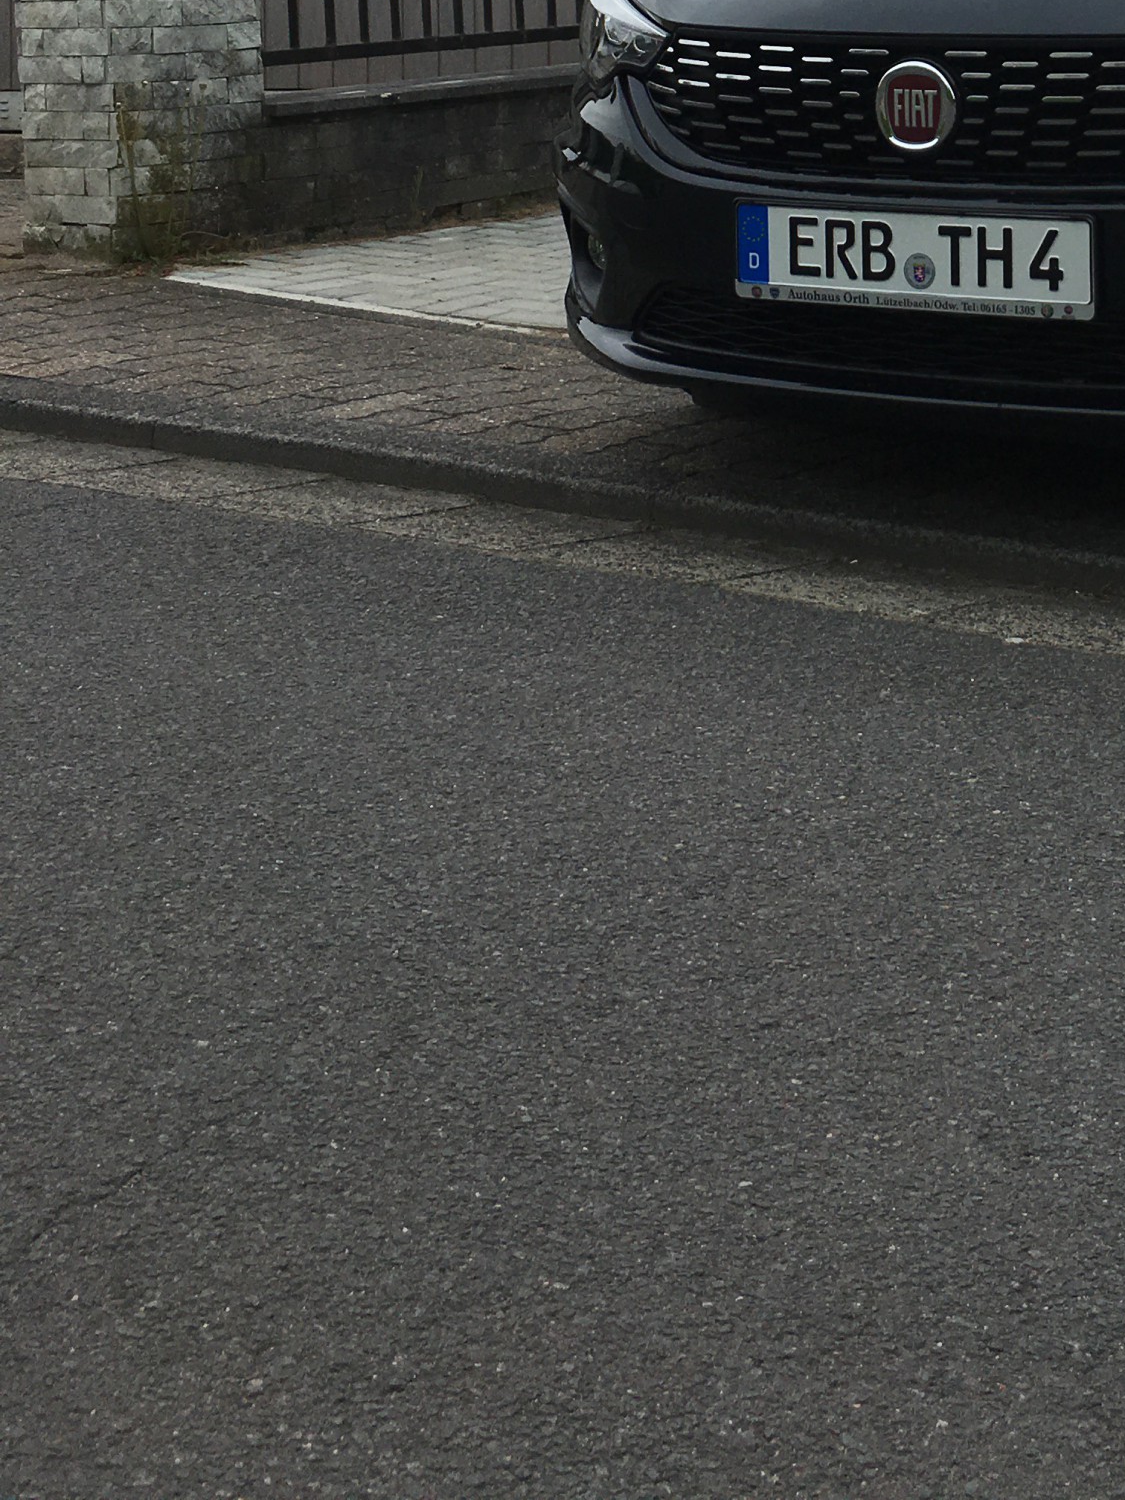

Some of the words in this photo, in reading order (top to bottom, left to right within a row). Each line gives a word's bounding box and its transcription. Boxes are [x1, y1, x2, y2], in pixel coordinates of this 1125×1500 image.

[894, 88, 938, 128] FIAT
[749, 252, 760, 269] D
[789, 216, 896, 281] ERB
[938, 226, 1013, 288] TH
[1030, 229, 1064, 291] 4
[788, 289, 840, 303] Autohaus
[844, 292, 869, 304] Orth
